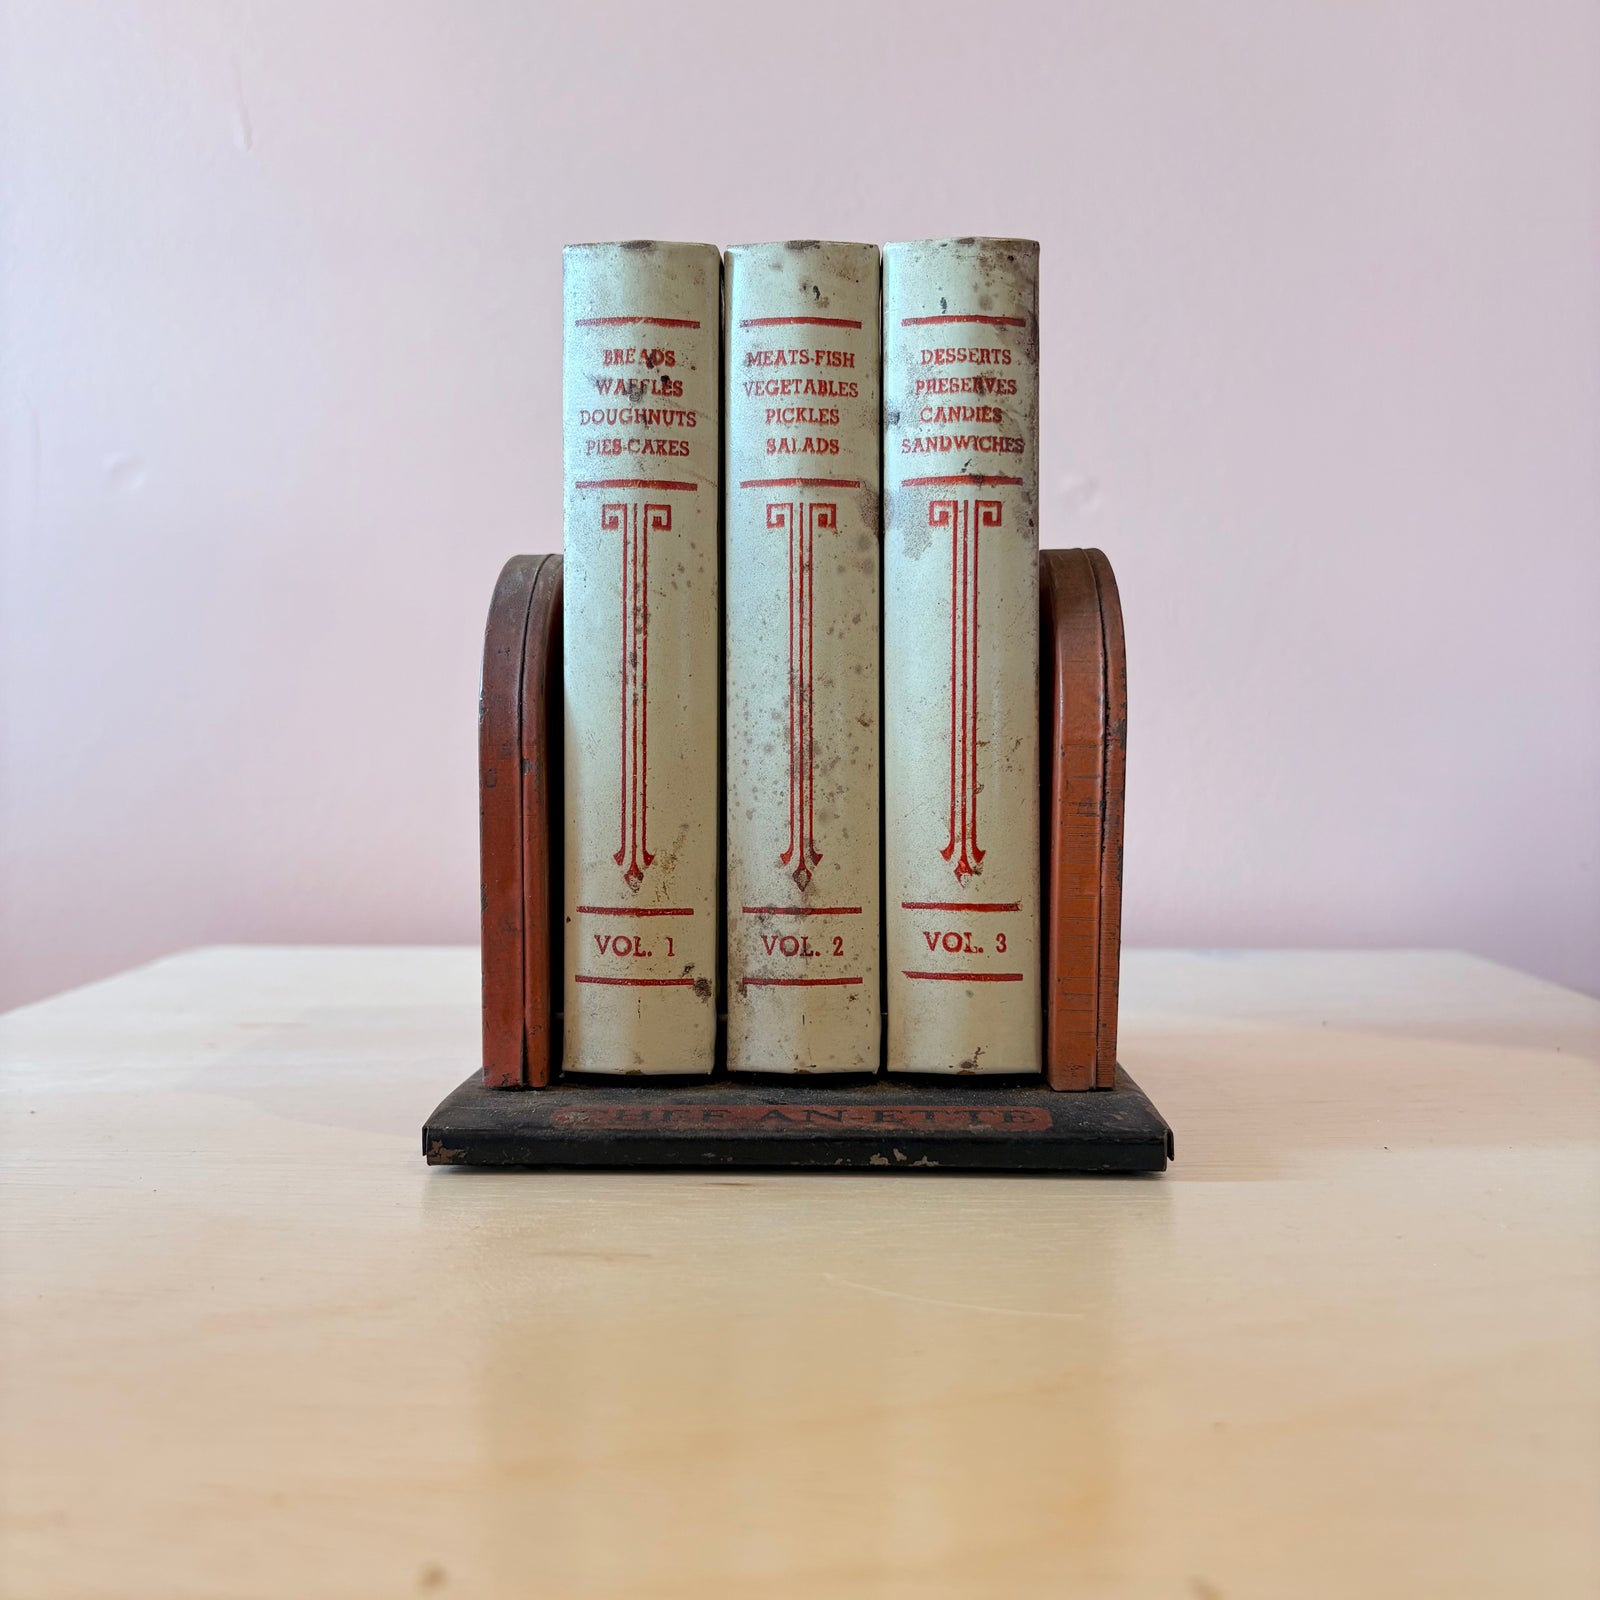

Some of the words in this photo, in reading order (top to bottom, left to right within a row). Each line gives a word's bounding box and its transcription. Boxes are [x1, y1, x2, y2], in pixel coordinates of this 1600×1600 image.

[602, 348, 676, 367] BREADS
[921, 348, 1012, 365] DESSERTS
[595, 378, 683, 398] WAFFLES
[743, 378, 859, 398] VEGETABLES
[915, 376, 1017, 395] PRESERVES
[580, 408, 697, 428] DOUGHNUTS
[765, 407, 840, 426] PICKLES
[920, 406, 1003, 423] CANDIES
[586, 438, 690, 456] PIES-CAKES
[766, 437, 840, 455] SALADS
[901, 435, 1025, 454] SANDWICHES
[594, 934, 653, 957] VOL.
[667, 936, 675, 957] 1
[762, 934, 820, 957] VOL.
[832, 936, 844, 957] 2
[923, 931, 984, 954] VOL.
[995, 933, 1008, 954] 3
